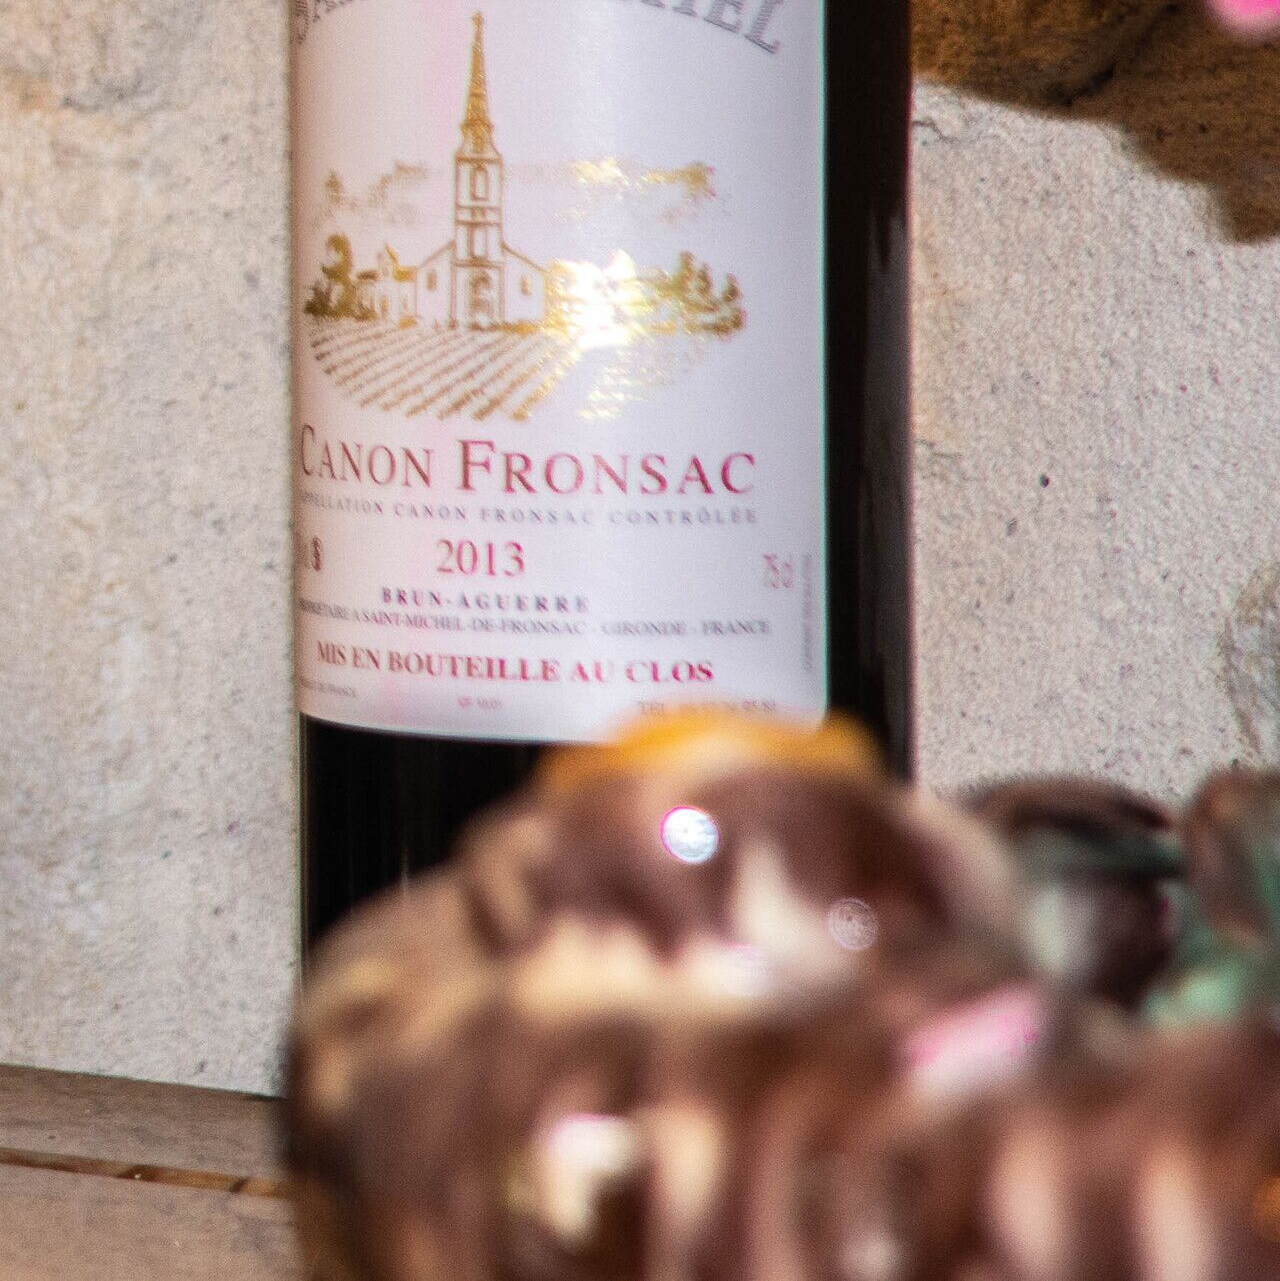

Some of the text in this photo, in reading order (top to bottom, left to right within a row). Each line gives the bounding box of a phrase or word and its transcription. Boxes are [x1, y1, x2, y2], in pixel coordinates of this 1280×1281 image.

[301, 424, 756, 495] CANON FRONSAC
[395, 503, 466, 520] CANON
[480, 506, 591, 525] FRONSAC
[436, 539, 525, 577] 2013
[382, 587, 588, 612] BRUN-AGUERRE
[318, 640, 714, 683] MIS EN BOUTEILLE AU CLOS
